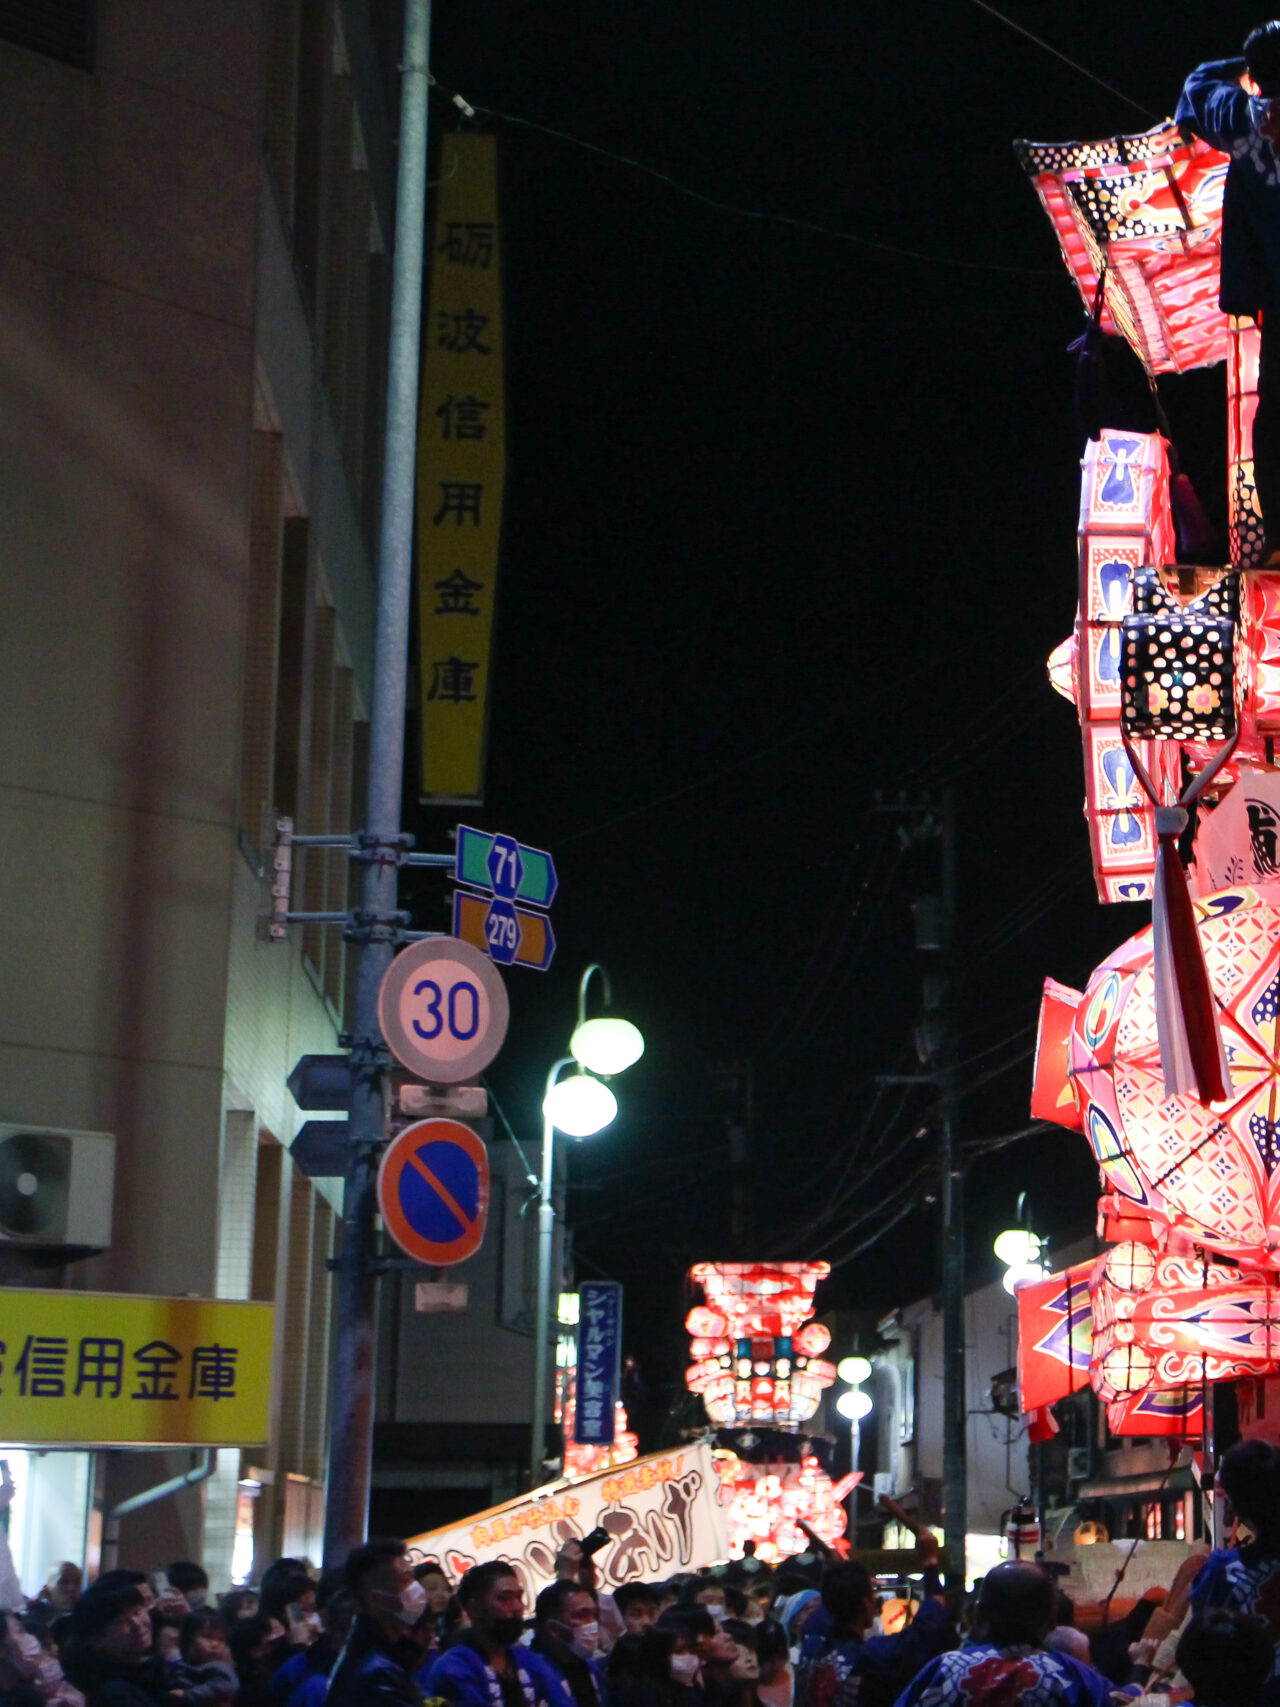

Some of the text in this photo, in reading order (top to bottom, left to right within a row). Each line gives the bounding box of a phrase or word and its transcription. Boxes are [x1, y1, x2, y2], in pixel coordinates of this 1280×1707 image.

[427, 221, 496, 703] 砺波信用金庫
[494, 845, 517, 889] 71
[488, 913, 517, 950] 279
[412, 979, 480, 1041] 30
[0, 1334, 239, 1402] 信用金庫
